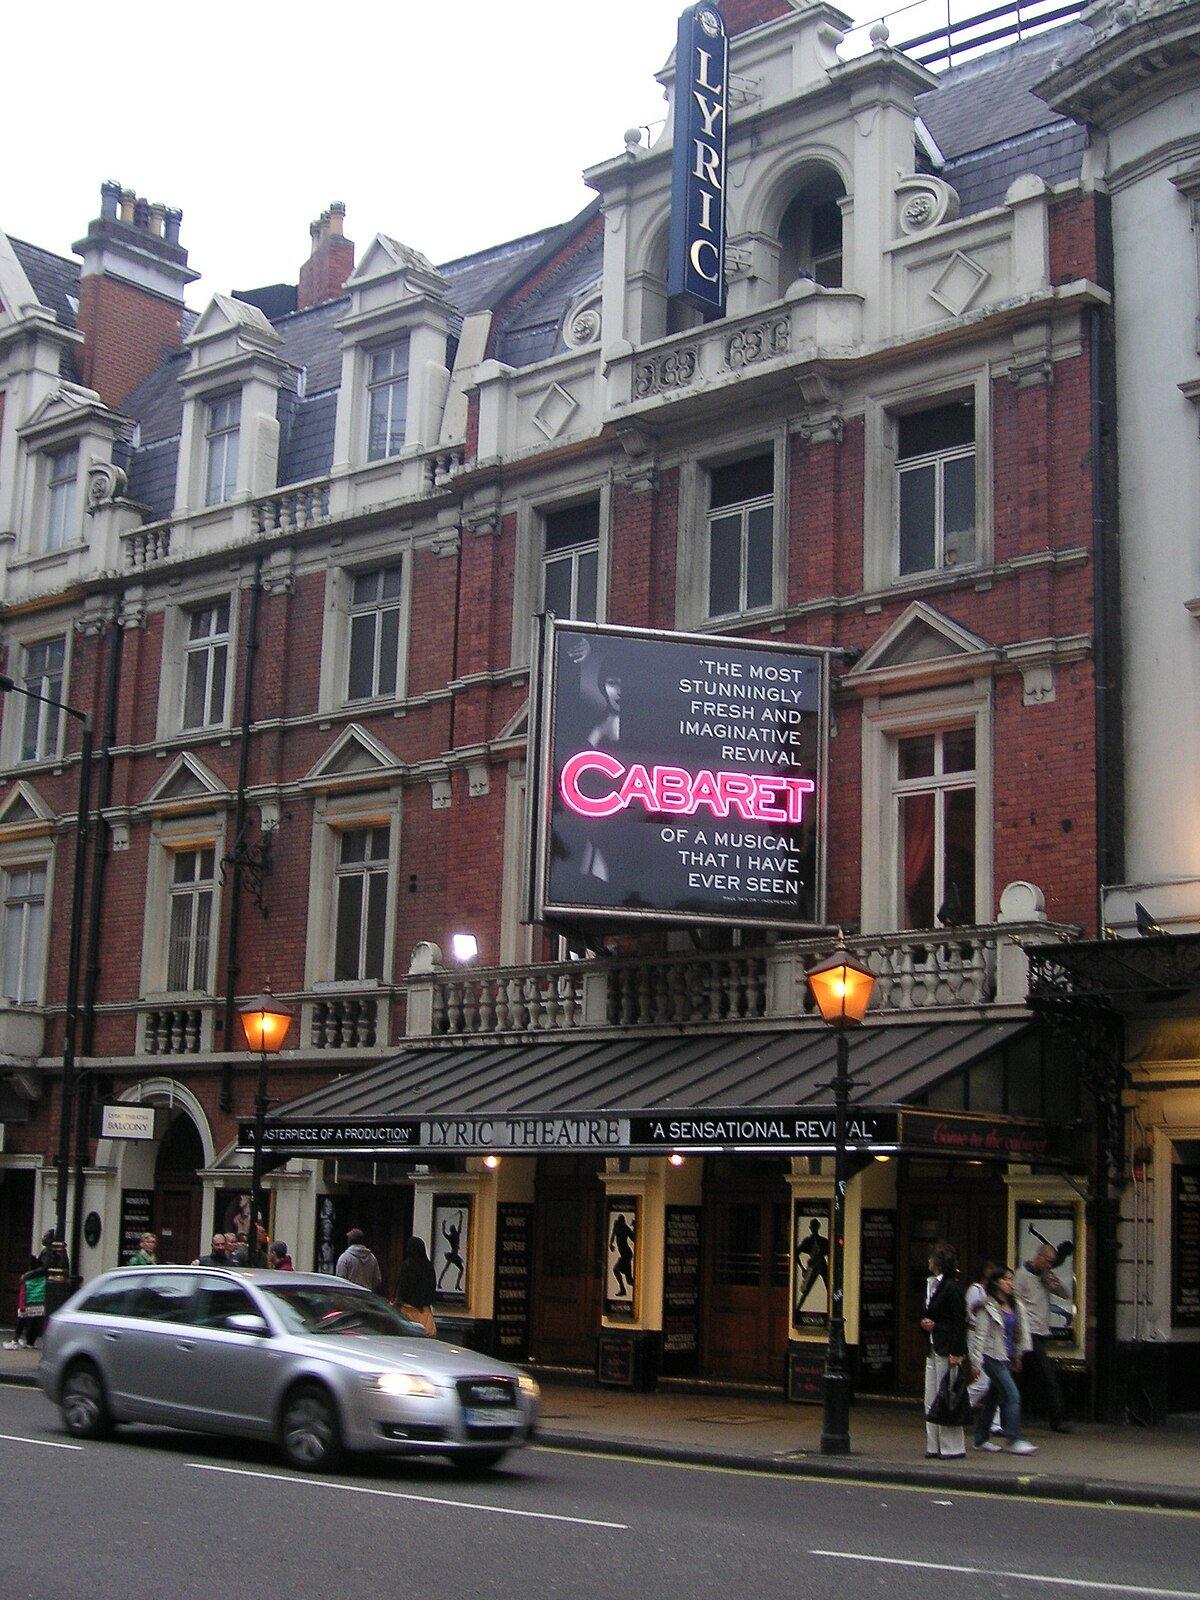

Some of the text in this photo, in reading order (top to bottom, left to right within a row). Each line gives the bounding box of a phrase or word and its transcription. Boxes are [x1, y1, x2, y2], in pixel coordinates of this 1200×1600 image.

[690, 47, 724, 283] LYRIC
[749, 664, 802, 683] MOST
[678, 680, 802, 703] STUNNINGLY
[690, 700, 801, 724] FRESH AND
[680, 721, 801, 745] IMAGINATIVE
[722, 746, 802, 766] REVIVAL
[560, 750, 815, 823] CABARET
[660, 828, 800, 852] OF A MUSICAL
[678, 850, 799, 874] THAT I HAVE
[688, 873, 740, 891] EVER
[107, 1121, 148, 1131] BALCONY
[262, 1128, 318, 1140] ASTERPIECE
[320, 1128, 334, 1140] OF
[335, 1128, 343, 1140] A
[427, 1119, 620, 1145] LYRIC THEATRE
[669, 1121, 790, 1139] SENSATIONAL
[795, 1120, 877, 1139] REVIAL'
